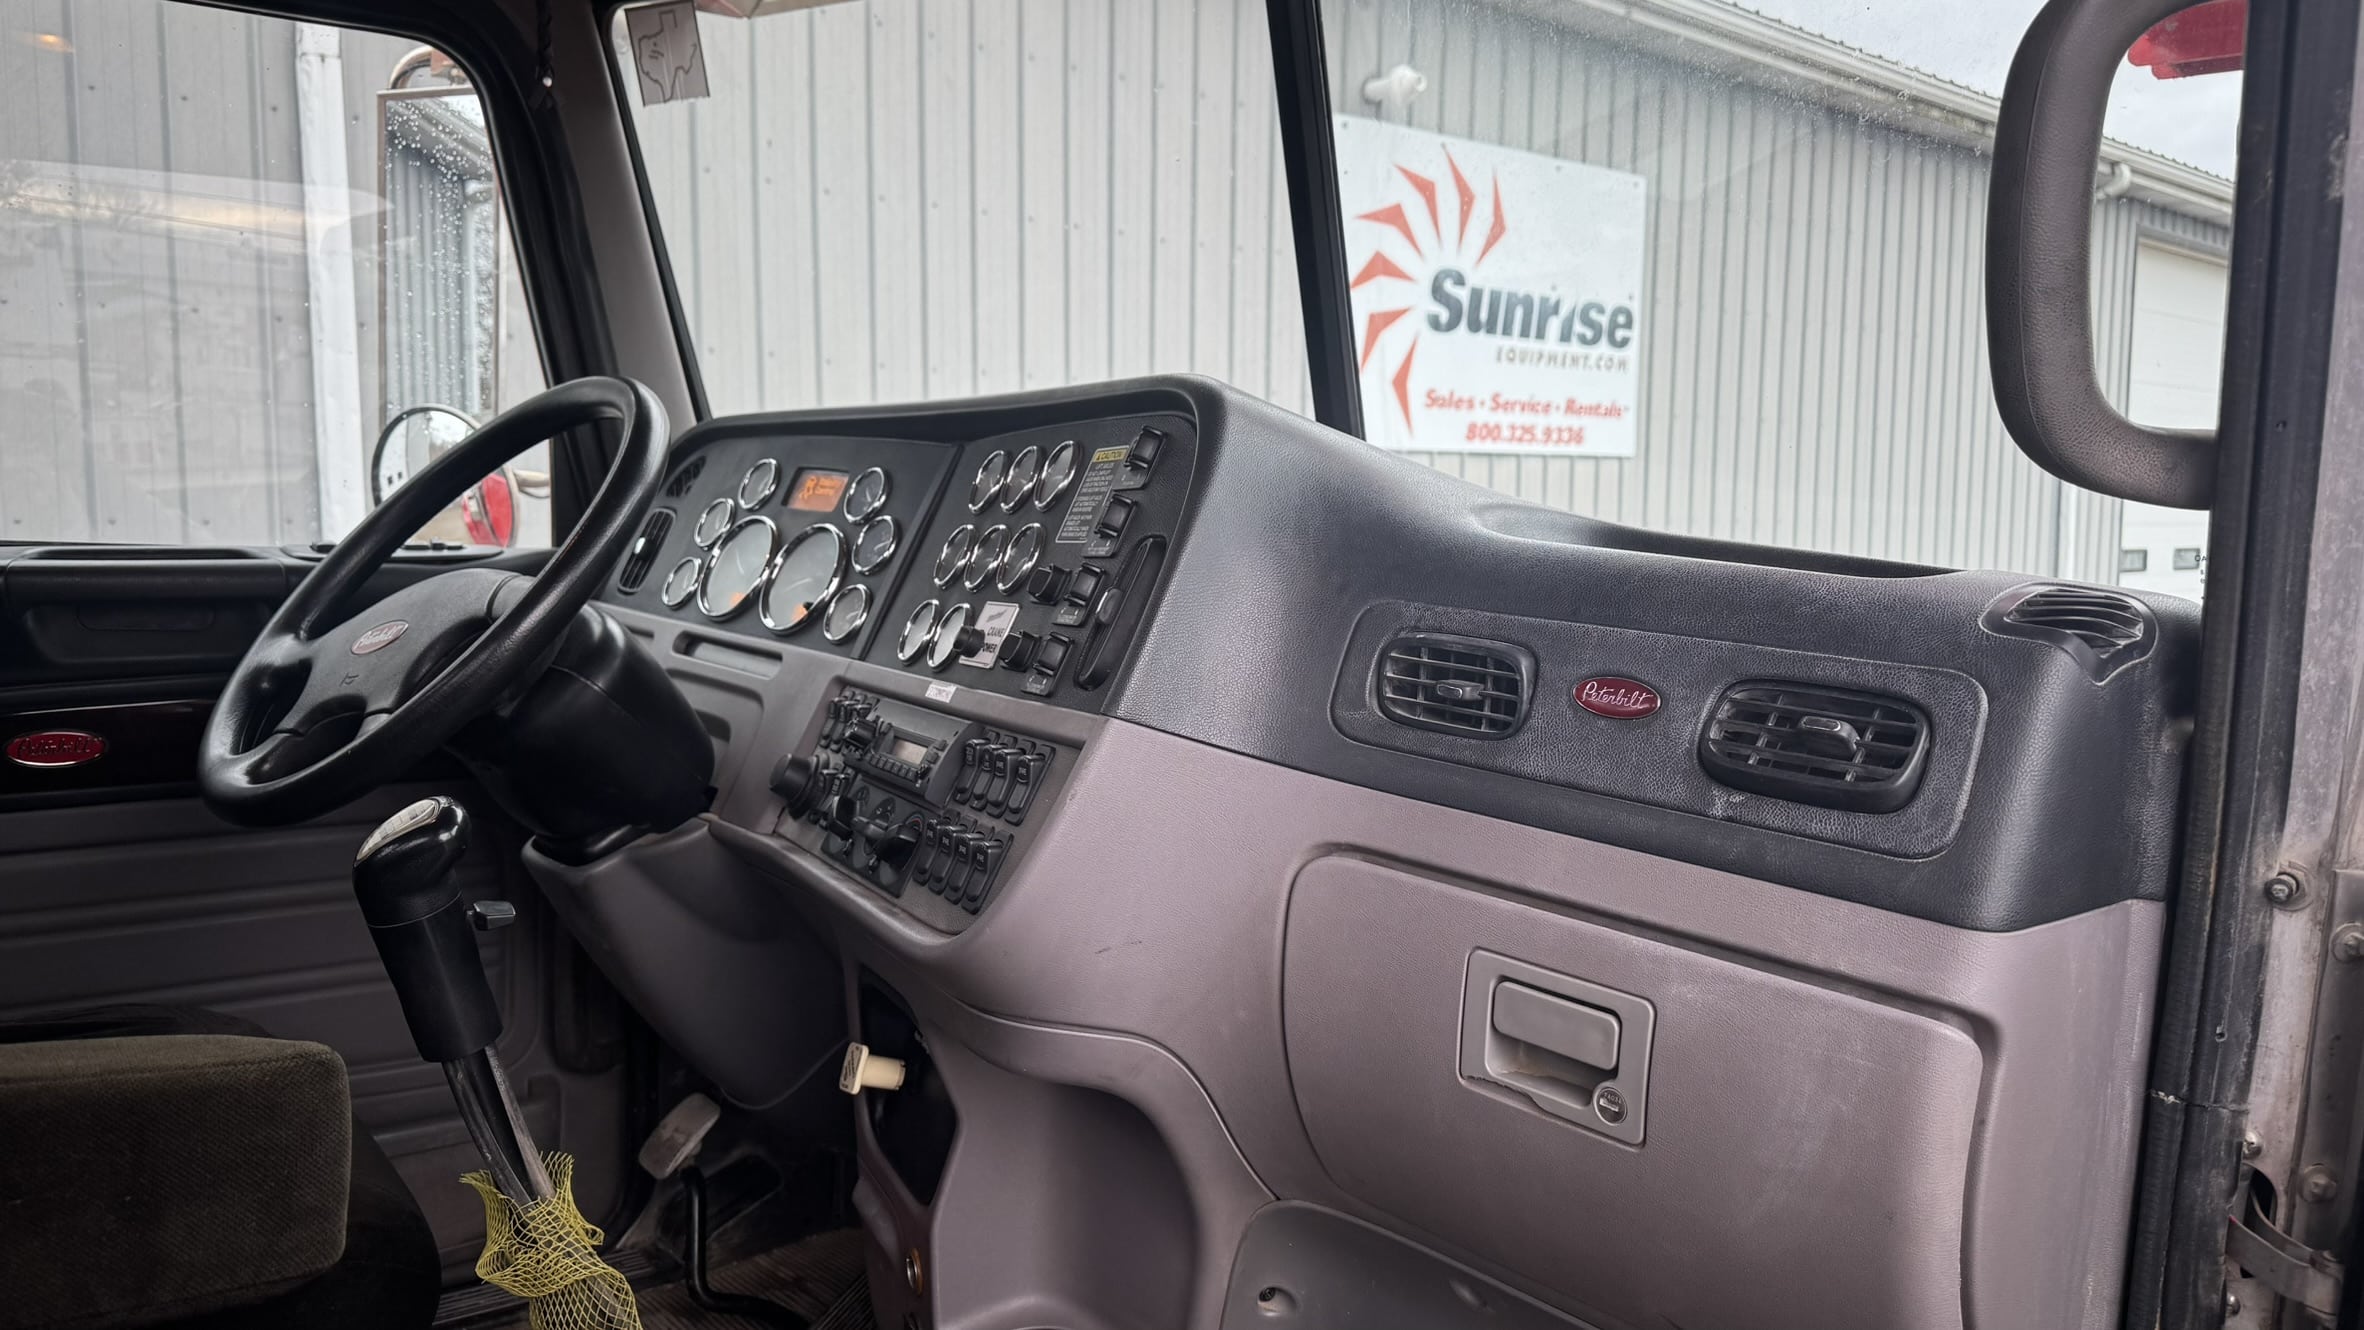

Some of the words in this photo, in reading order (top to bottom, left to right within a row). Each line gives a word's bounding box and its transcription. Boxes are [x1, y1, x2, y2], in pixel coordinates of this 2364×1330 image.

[1427, 267, 1634, 348] Sunrise
[1496, 347, 1629, 372] EQUIPMENT.COM
[1424, 388, 1474, 411] Sales
[1489, 391, 1552, 415] Service
[1564, 398, 1622, 419] Rentals
[1466, 421, 1585, 446] 800.325.9336
[1581, 681, 1654, 709] Peterbilt
